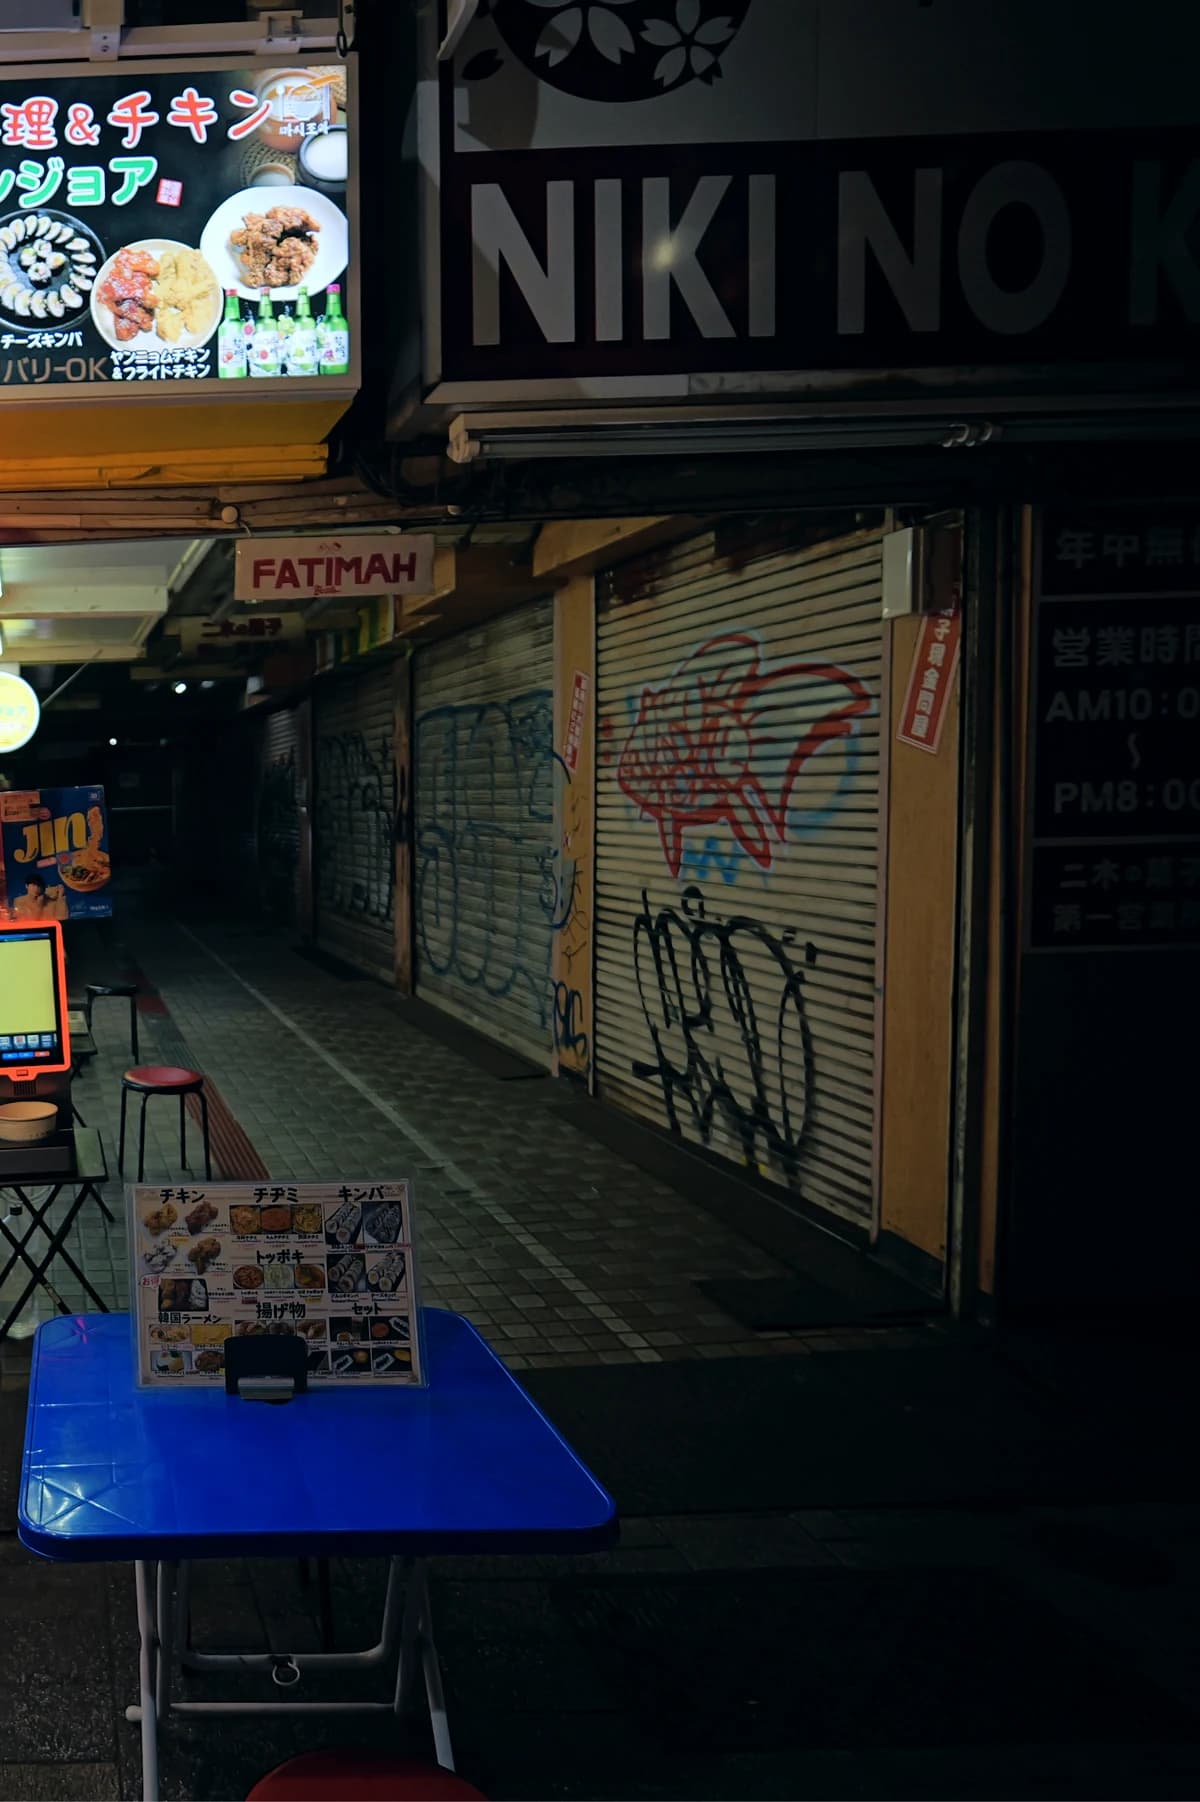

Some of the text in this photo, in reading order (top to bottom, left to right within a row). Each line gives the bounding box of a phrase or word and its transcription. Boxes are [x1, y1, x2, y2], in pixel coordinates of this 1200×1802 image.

[471, 174, 776, 346] NIKI
[836, 160, 1073, 335] NO
[110, 348, 211, 365] ヤンニョムチキン
[253, 553, 417, 589] FATIMAH
[160, 1188, 206, 1204] チキン
[253, 1188, 299, 1203] チヂミ
[256, 1249, 304, 1265] トッポキ
[255, 1302, 306, 1320] 揚げ物
[352, 1302, 382, 1316] セット
[158, 1311, 222, 1325] 韓国ラーメン
